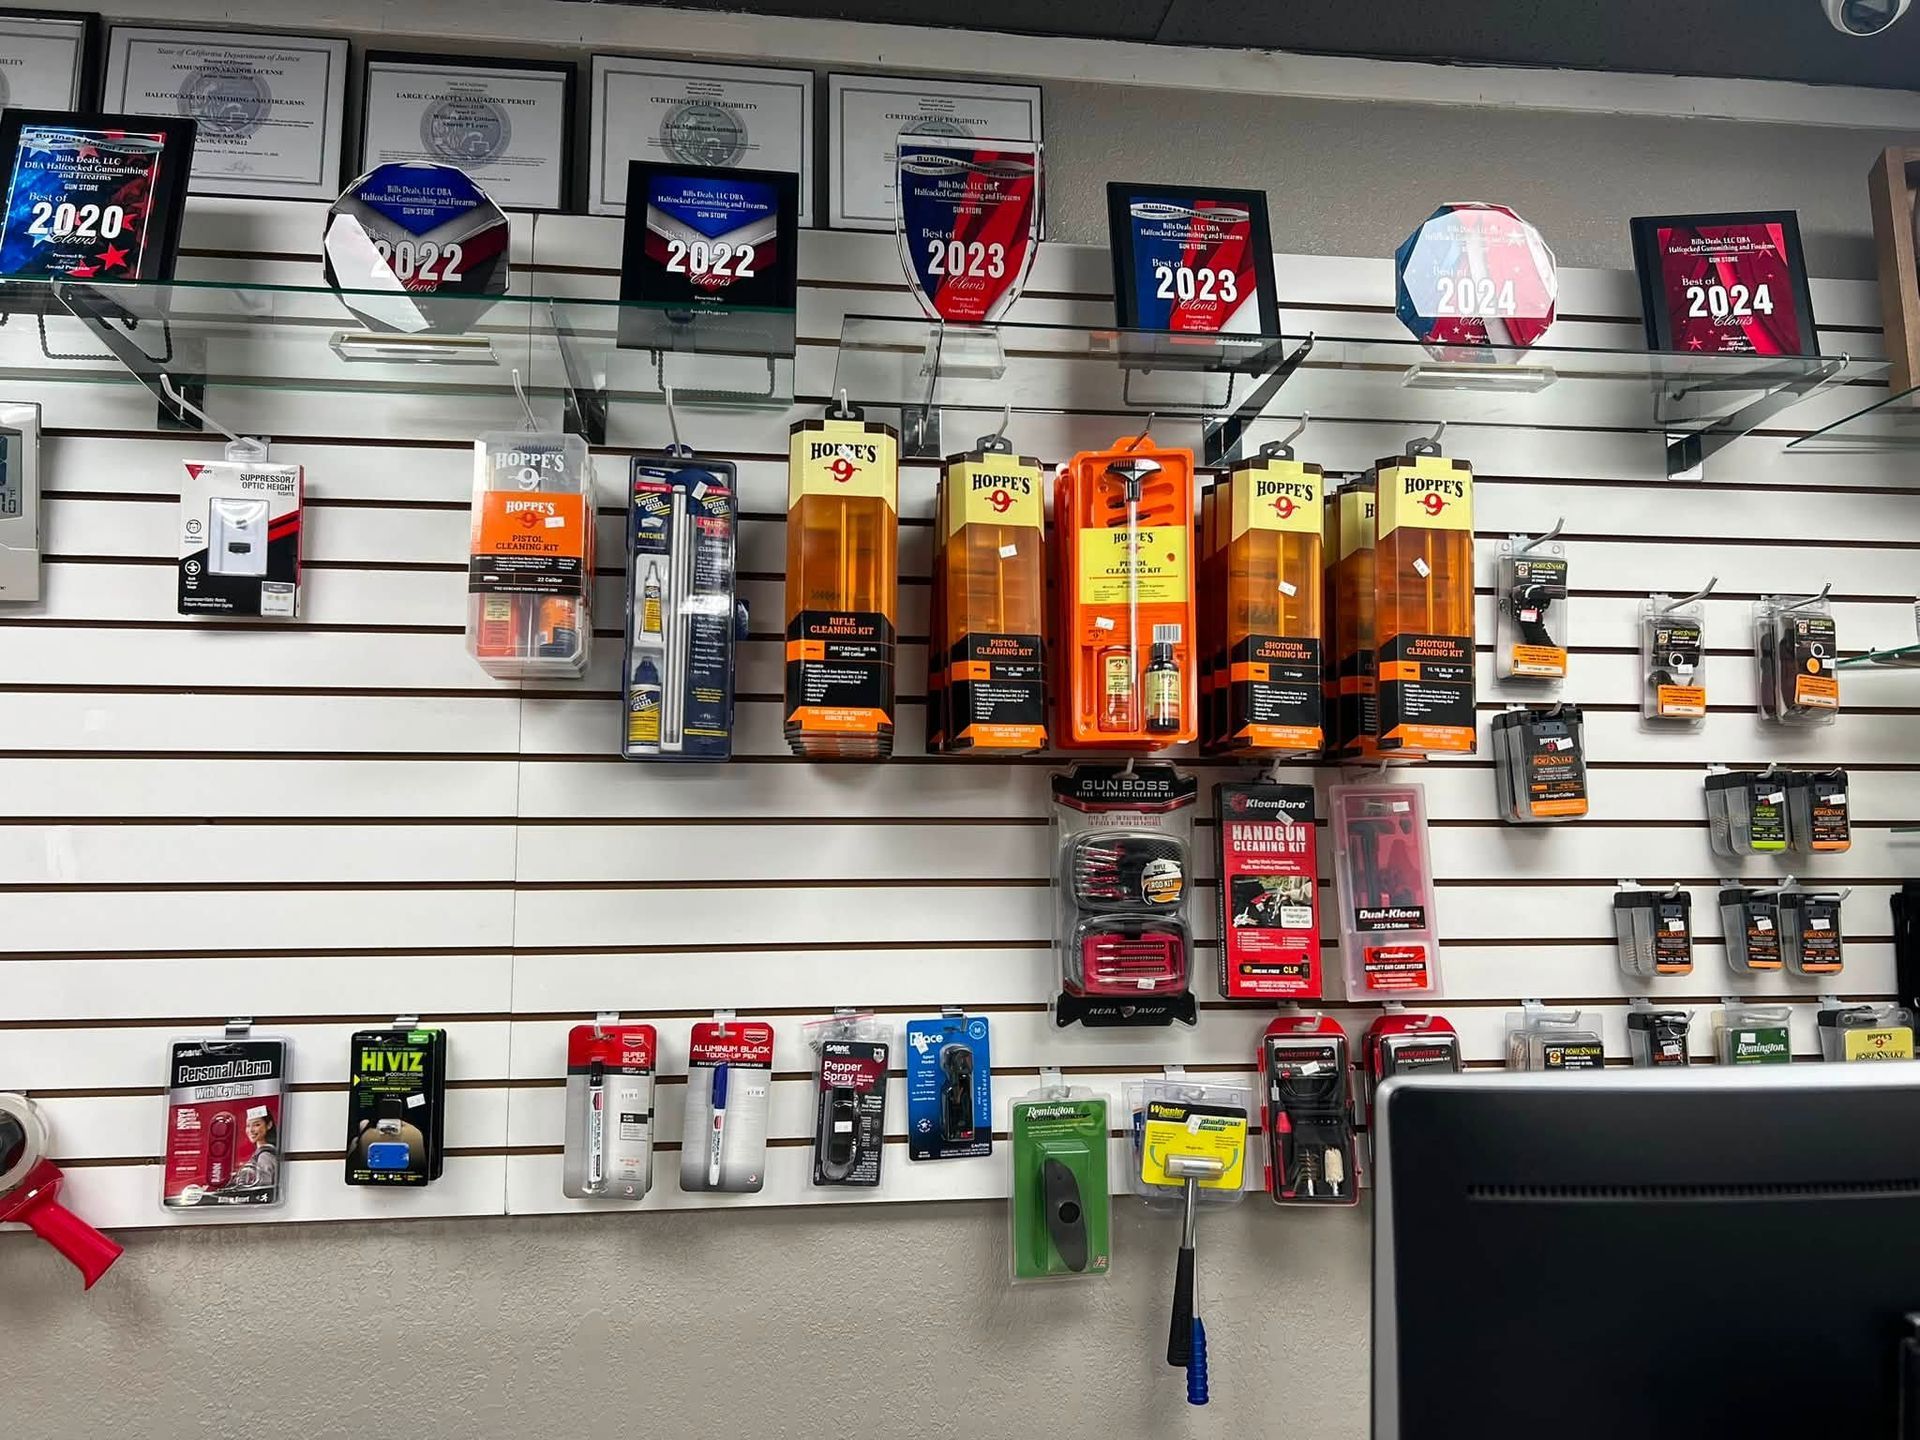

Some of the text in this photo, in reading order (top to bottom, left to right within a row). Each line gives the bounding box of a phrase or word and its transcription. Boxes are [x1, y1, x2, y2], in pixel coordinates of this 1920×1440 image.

[171, 64, 220, 72] AMMUNITION
[145, 91, 196, 100] HALFCOCKED
[268, 98, 305, 106] FIREARMS
[396, 92, 422, 100] LARGE
[507, 98, 536, 106] PERMIT
[885, 113, 933, 122] CERTIFICATE
[56, 154, 74, 162] Bills
[76, 157, 100, 165] Deals,
[24, 161, 149, 177] DBA Halfcocked Gunsmithing
[58, 171, 112, 181] and Firearms
[64, 183, 99, 192] GUN STORE
[422, 186, 436, 196] LLC
[437, 187, 452, 197] DBA
[29, 192, 68, 202] Best of
[402, 206, 435, 216] GUN STORE
[742, 201, 768, 210] Firearms
[952, 206, 982, 215] GUN STORE
[28, 201, 124, 240] 2020
[696, 211, 709, 219] GUN
[52, 230, 98, 245] Clovis
[922, 228, 957, 239] Best of
[370, 240, 463, 282] 2022
[666, 239, 755, 278] 2022
[928, 240, 1005, 279] 2023
[1152, 258, 1185, 268] Best of
[689, 271, 731, 288] Clovis
[946, 273, 985, 291] Clovis
[1155, 266, 1238, 303] 2023
[1682, 277, 1716, 286] Best of
[1437, 277, 1516, 316] 2024
[1687, 284, 1774, 318] 2024
[1178, 297, 1218, 311] Clovis
[1711, 313, 1753, 327] Clovis
[495, 452, 565, 473] HOPPE'S
[831, 458, 854, 483] 9
[240, 473, 295, 484] SUPPRESSOR/
[518, 467, 541, 491] 9
[972, 473, 1031, 495] HOPPE'S
[242, 482, 295, 492] OPTIC HEIGHT
[1256, 480, 1314, 502] HOPPE'S
[1404, 478, 1464, 498] HOPPE'S
[636, 496, 660, 507] Tetra
[645, 501, 664, 512] Gun
[703, 500, 725, 510] Tetra
[991, 489, 1011, 513] 9
[1424, 493, 1444, 516] 9
[505, 500, 556, 515] HOPPE'S
[1275, 496, 1293, 520] 9
[511, 534, 544, 543] PISTOL
[1113, 532, 1154, 545] HOE'S
[495, 542, 560, 552] CLEANING KIT
[1106, 566, 1162, 574] CLEANG KIT
[829, 616, 856, 626] RIFLE
[810, 625, 874, 635] CLEANING KIT
[990, 639, 1019, 647] PISTOL
[1264, 641, 1303, 650] SHOTGUN
[1415, 639, 1456, 649] SHOTGUN
[976, 646, 1034, 656] CLEANING KIT
[1256, 649, 1312, 660] CLEANING KIT
[1406, 647, 1465, 658] CLEANING KIT
[632, 699, 652, 711] Gun
[1082, 780, 1170, 791] GUN BOSS
[1246, 798, 1306, 809] KleenBore
[1232, 825, 1306, 842] HANDGUN
[1233, 841, 1306, 852] CLEANING KIT
[1359, 908, 1420, 919] Dual-Kleen
[1283, 966, 1299, 974] CLP
[910, 1032, 944, 1046] ace
[1867, 1033, 1893, 1042] HOPPE'S
[692, 1044, 770, 1054] ALUMINUM BLACK
[1737, 1043, 1786, 1055] Remington
[1875, 1040, 1884, 1049] 9
[1398, 1050, 1440, 1058] WINCHESTER
[1551, 1051, 1560, 1062] 9
[178, 1059, 272, 1083] Personal Alarm
[824, 1060, 862, 1072] Pepper
[823, 1071, 854, 1086] Spray
[195, 1084, 254, 1099] With Key Ring
[1027, 1105, 1075, 1118] Remington
[1150, 1104, 1186, 1116] Wheeler
